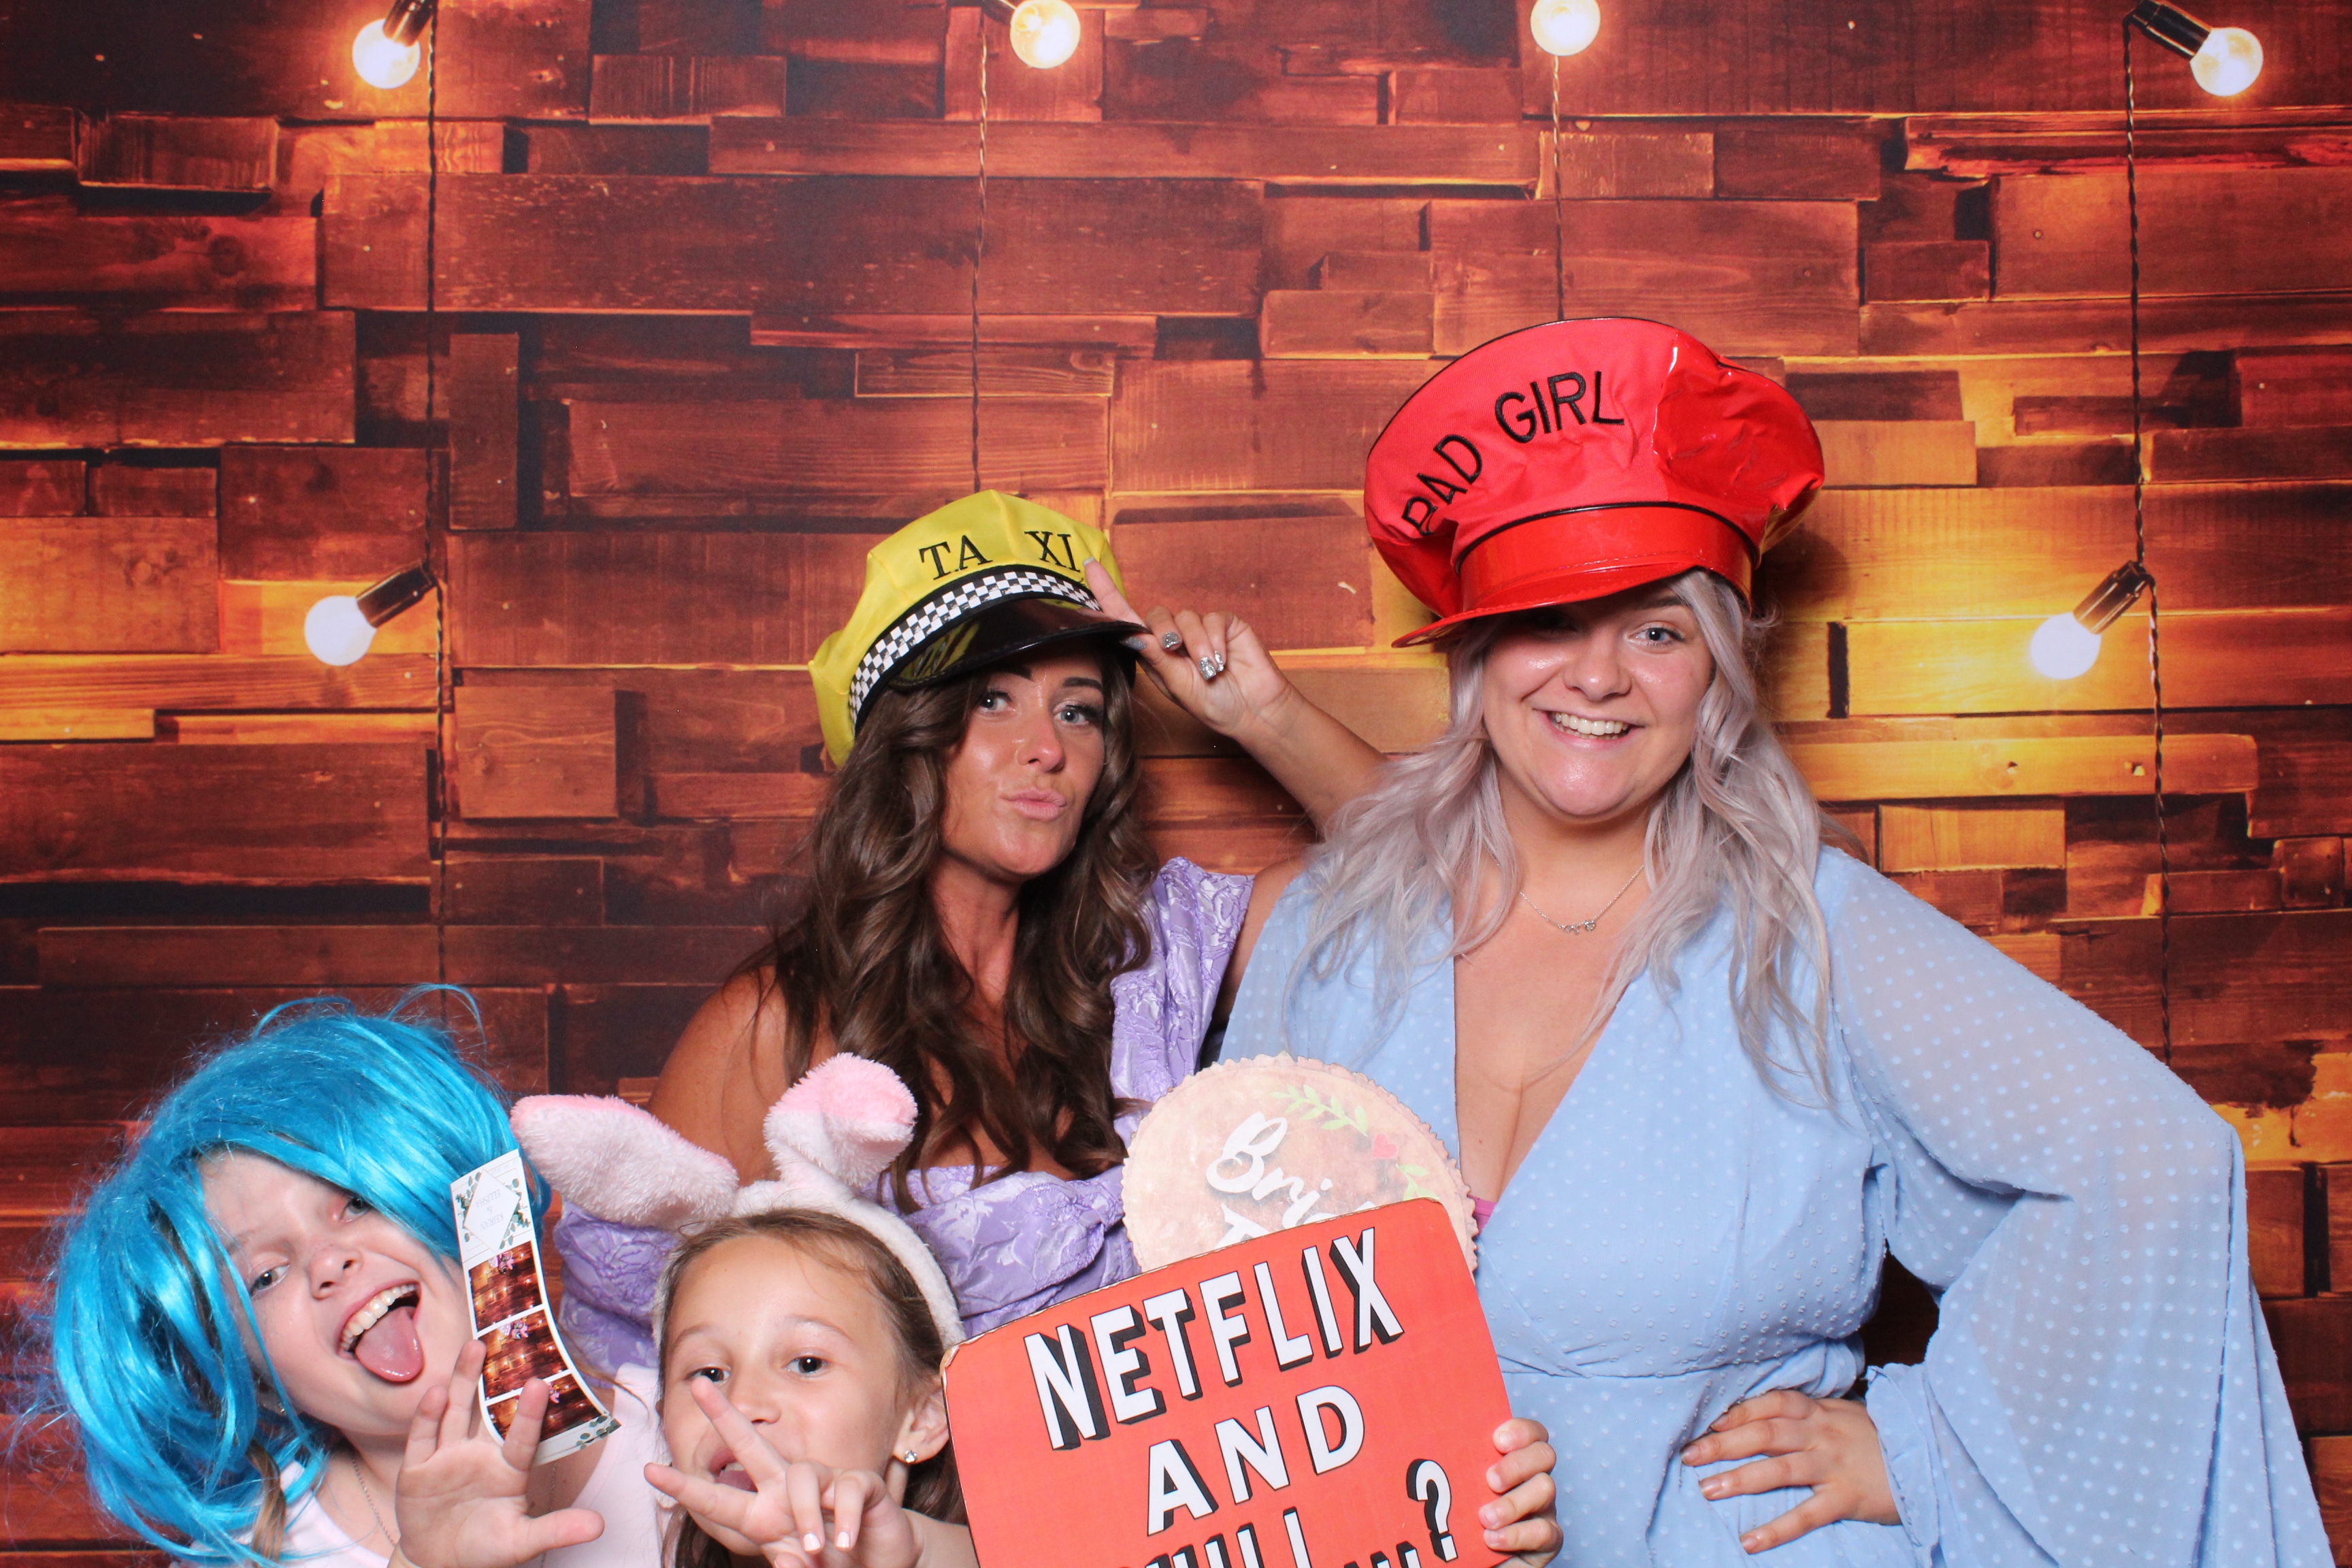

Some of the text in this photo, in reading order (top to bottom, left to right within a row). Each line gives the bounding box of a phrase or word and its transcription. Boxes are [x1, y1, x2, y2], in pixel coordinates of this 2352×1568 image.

[1494, 371, 1625, 443] GIRL
[1024, 1227, 1404, 1451] NETFLIX
[1147, 1385, 1365, 1536] AND
